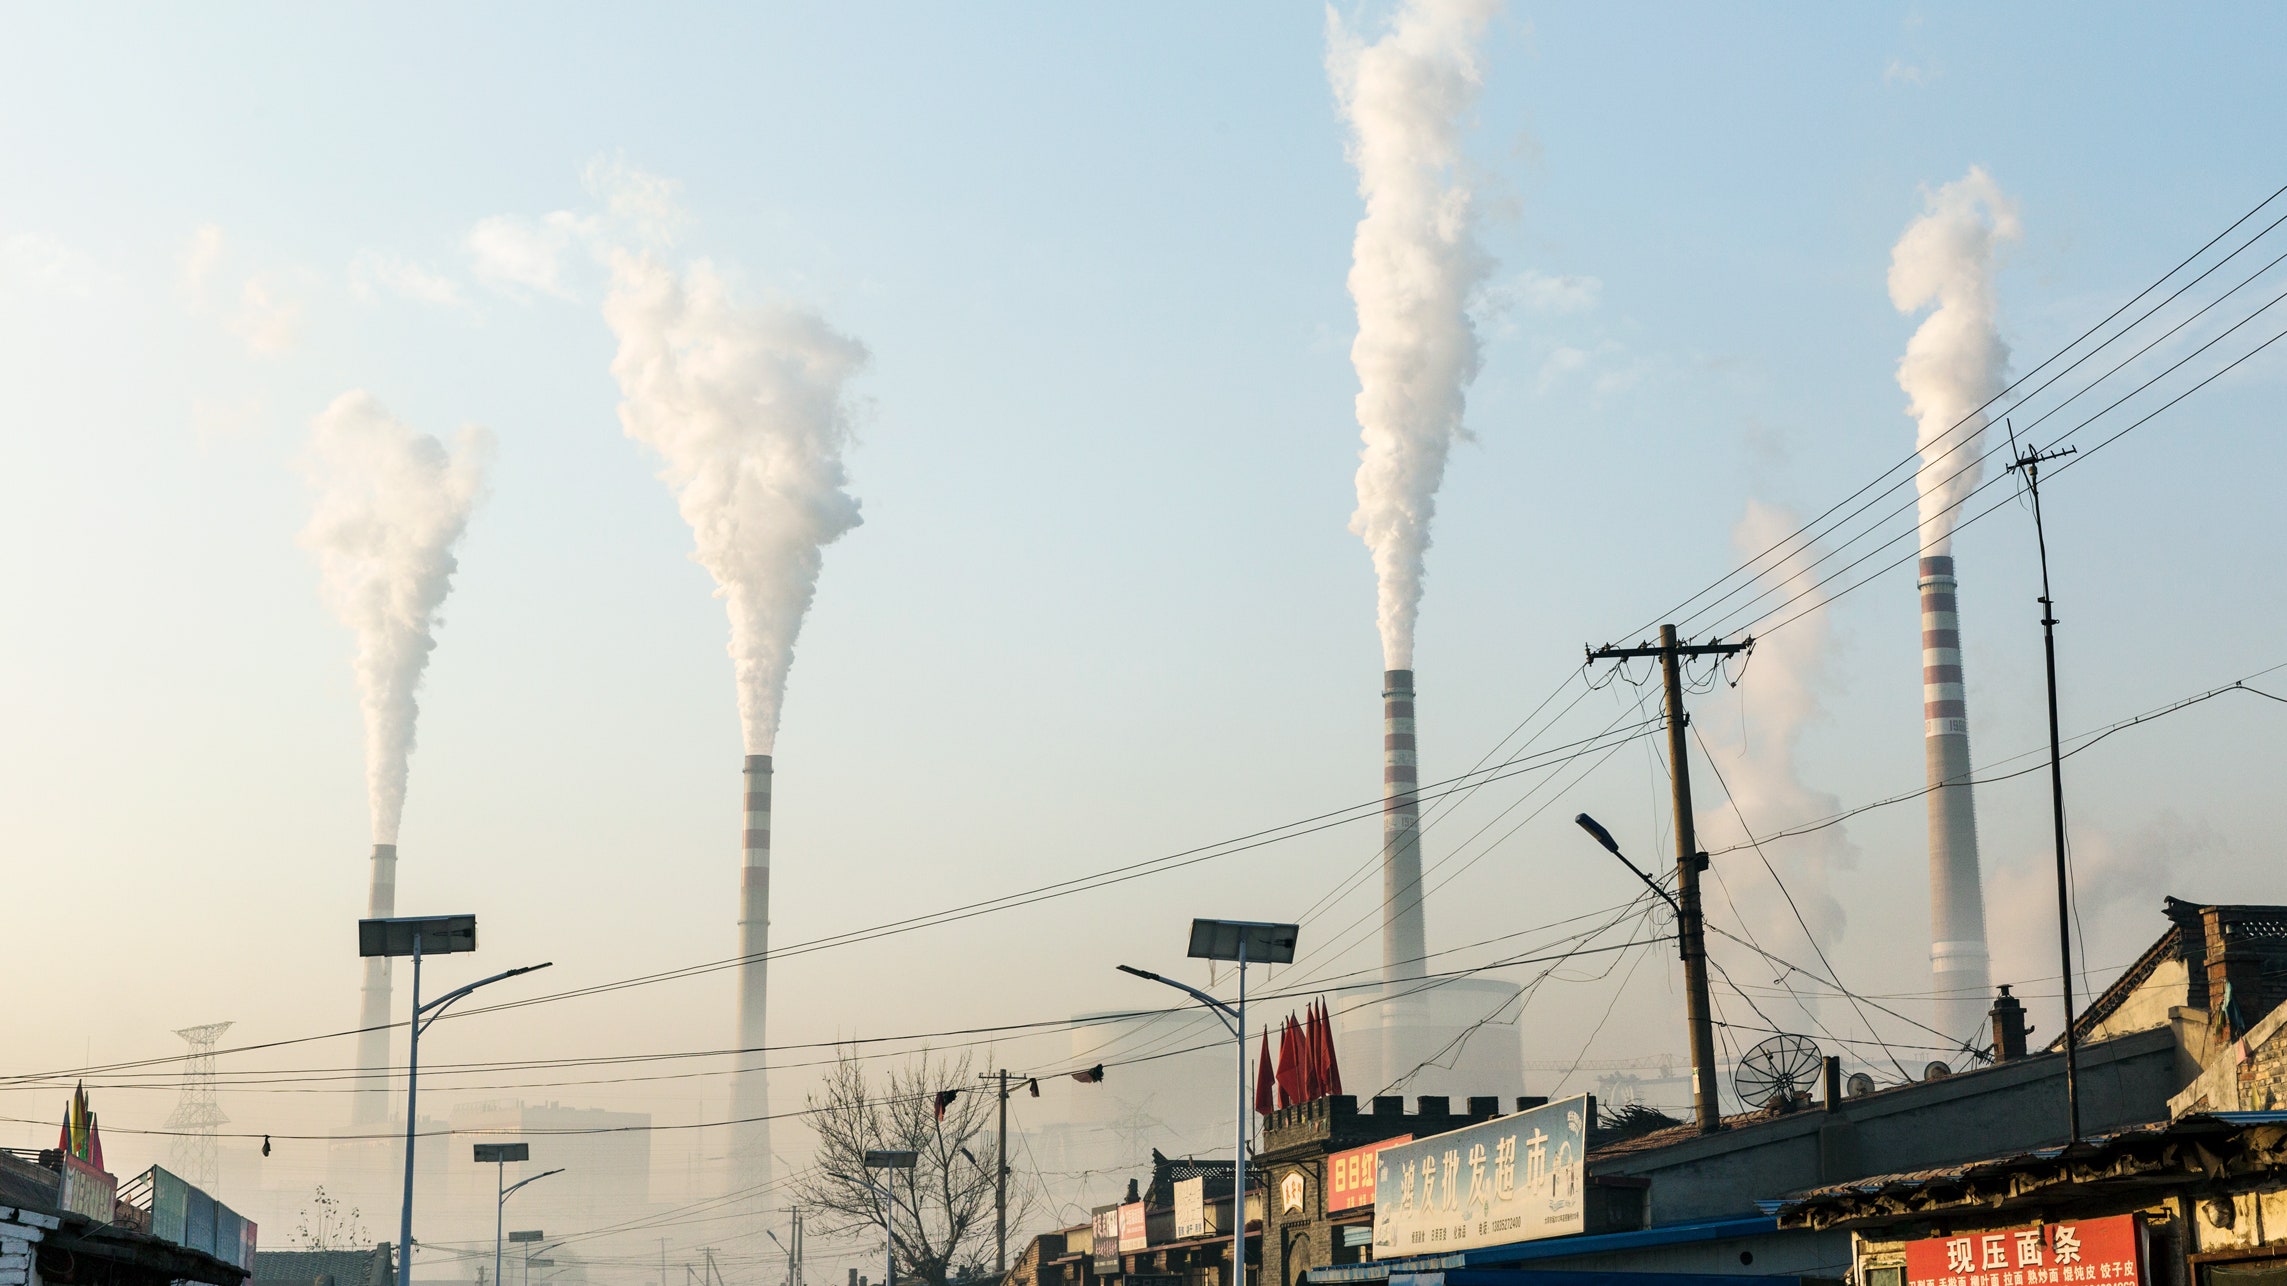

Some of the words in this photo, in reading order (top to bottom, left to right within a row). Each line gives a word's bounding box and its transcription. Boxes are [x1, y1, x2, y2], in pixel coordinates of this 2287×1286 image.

[1335, 1152, 1377, 1193] 日日红
[1400, 1127, 1549, 1219] 鸿发批发超市
[1946, 1225, 2082, 1275] 现压面条
[2003, 1270, 2023, 1286] 拉面
[2063, 1264, 2096, 1281] 馄饨皮
[2100, 1260, 2135, 1278] 饺子皮
